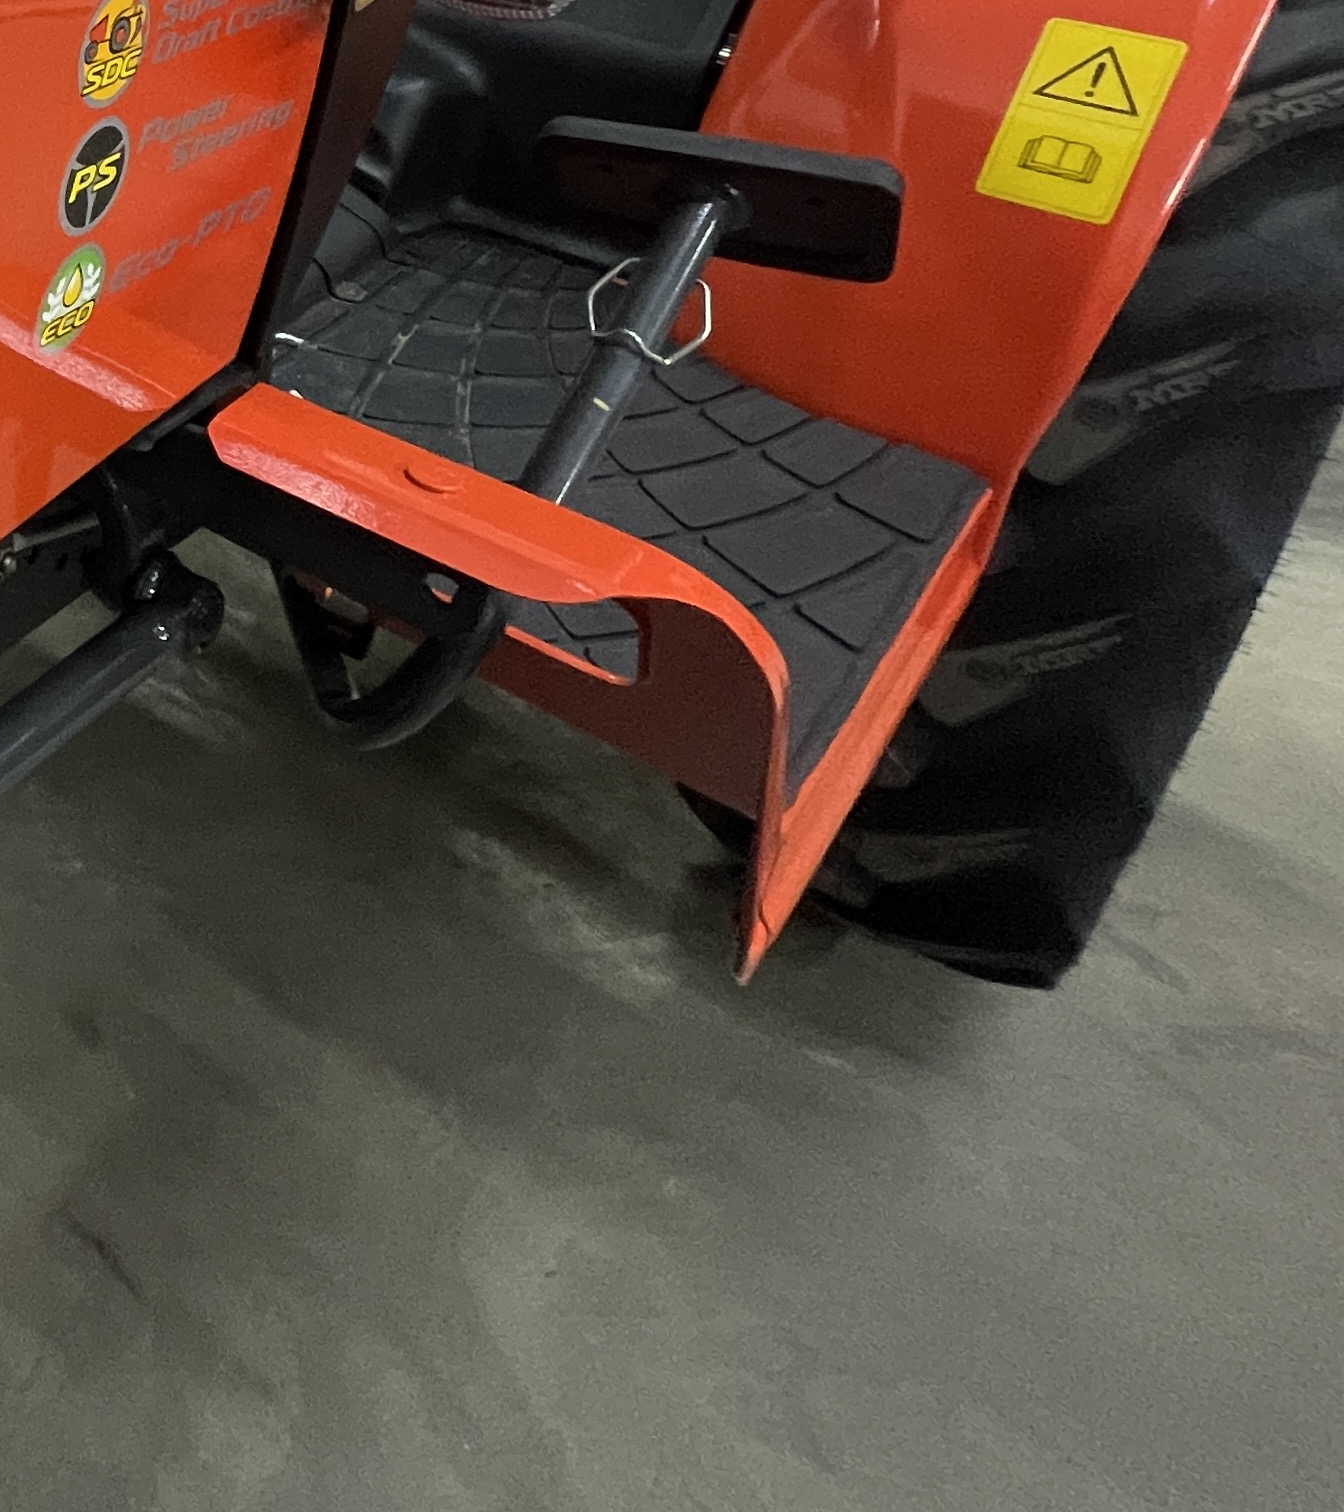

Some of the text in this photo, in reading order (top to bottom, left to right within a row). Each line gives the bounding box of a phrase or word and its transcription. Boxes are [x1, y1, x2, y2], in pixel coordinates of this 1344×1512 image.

[82, 48, 142, 97] SDC
[68, 152, 121, 204] PS
[40, 300, 95, 348] ECO
